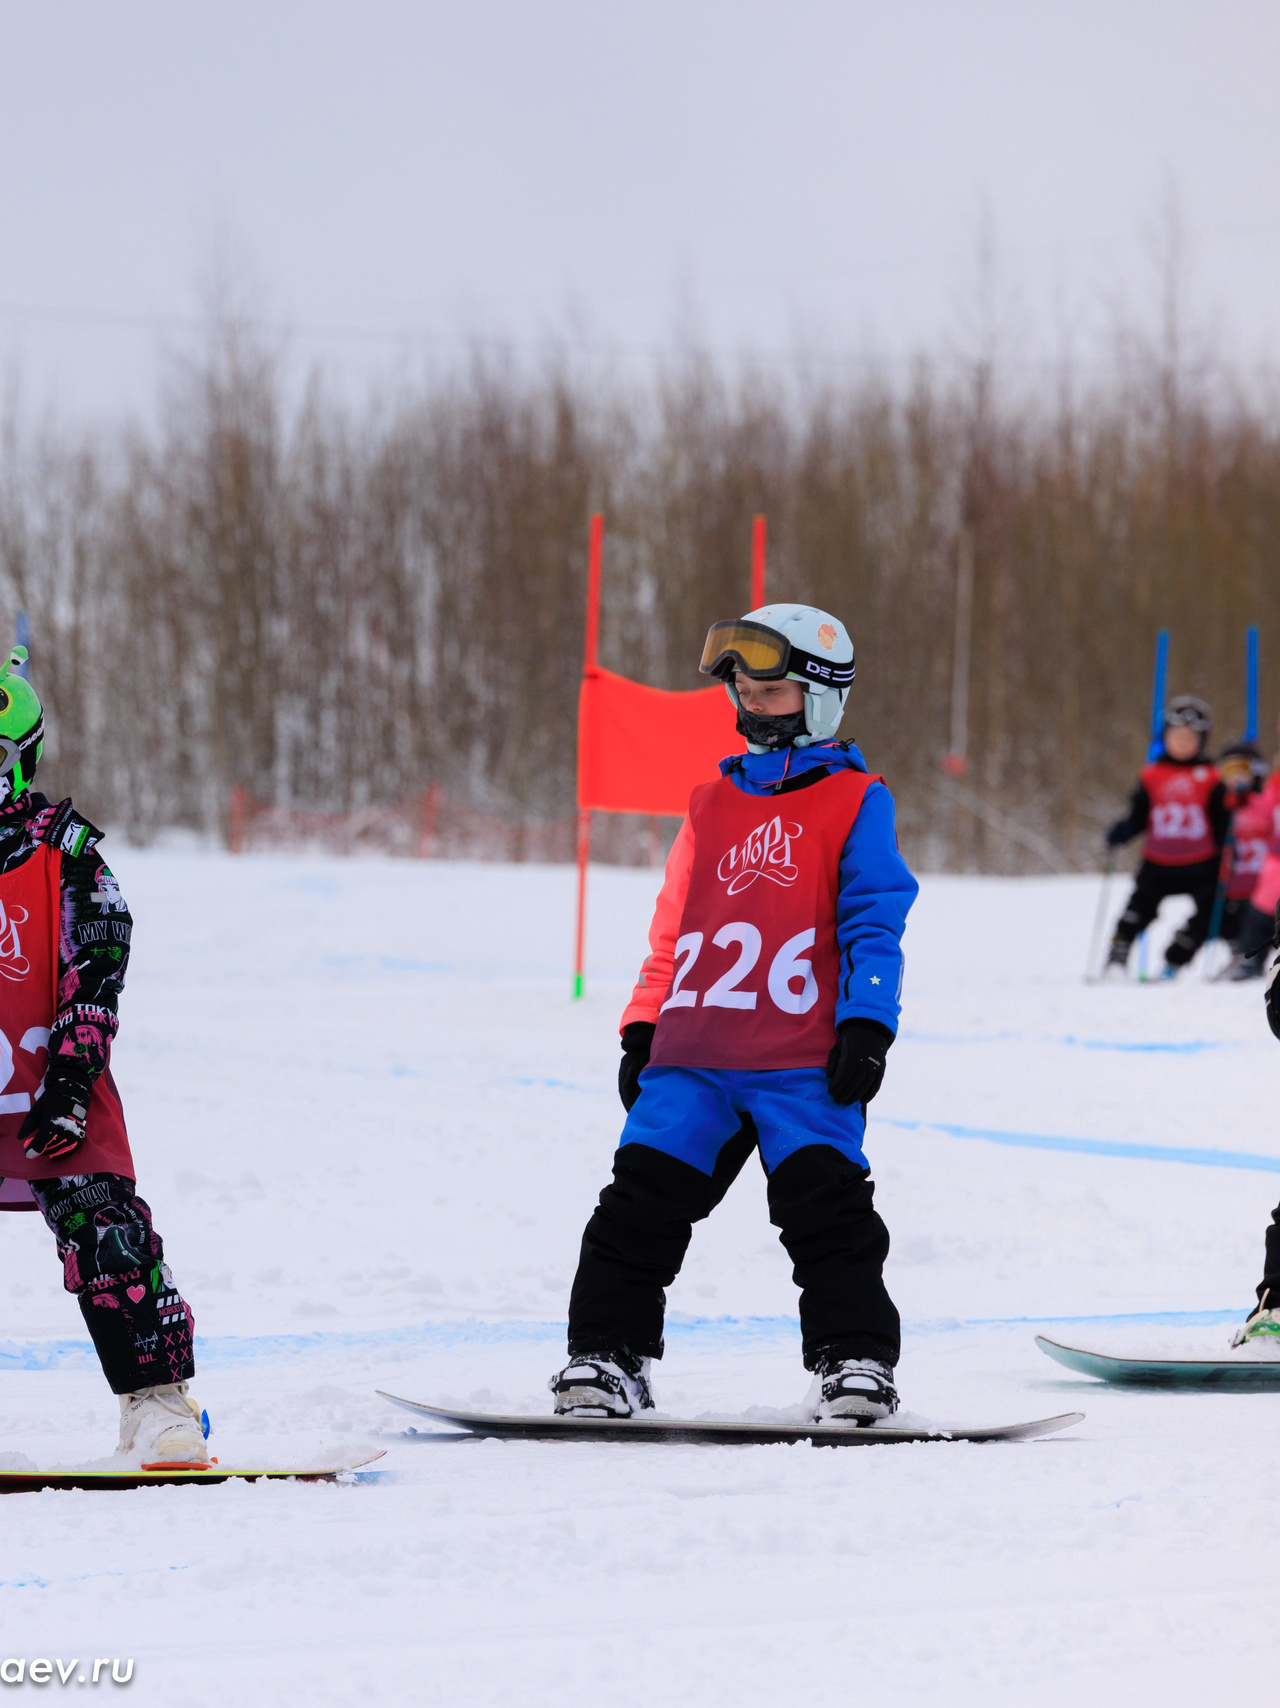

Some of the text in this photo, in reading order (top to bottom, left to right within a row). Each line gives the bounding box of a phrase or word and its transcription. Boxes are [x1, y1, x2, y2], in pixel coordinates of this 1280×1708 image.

[78, 921, 108, 945] MY
[658, 921, 819, 1015] 226
[72, 1181, 112, 1209] WAY
